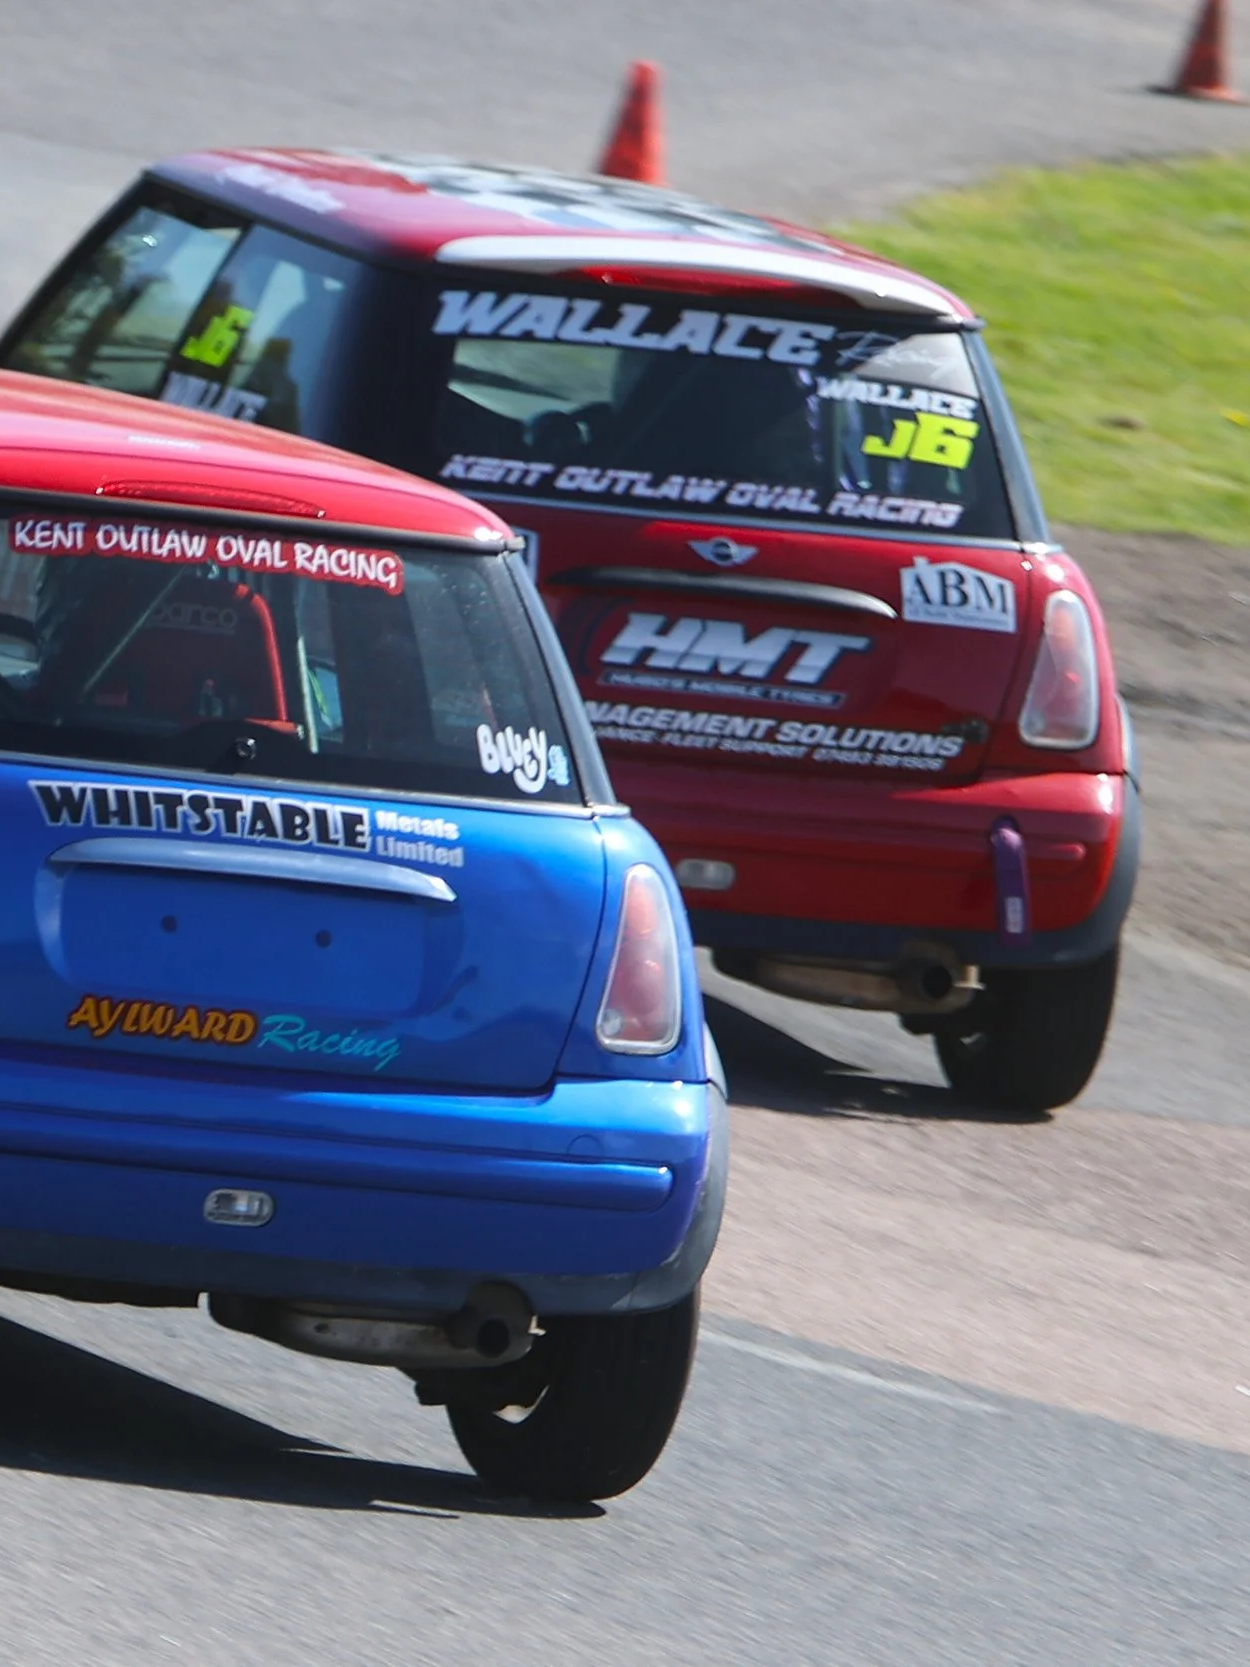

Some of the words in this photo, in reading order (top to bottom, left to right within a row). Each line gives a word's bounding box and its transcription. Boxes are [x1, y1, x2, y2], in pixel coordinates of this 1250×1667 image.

[179, 305, 253, 368] J6
[433, 289, 836, 366] WALLACE
[816, 375, 978, 420] WALLACE
[861, 411, 980, 470] J6
[440, 454, 553, 487] KENT
[554, 466, 726, 504] OUTLAW
[725, 482, 822, 514] OVAL
[827, 492, 964, 530] RACING
[14, 520, 86, 549] KENT
[96, 524, 207, 559] OUTLAW
[216, 535, 287, 569] OVAL
[294, 541, 398, 590] RACING
[907, 568, 1009, 615] ABM
[601, 614, 870, 683] HMT
[583, 700, 777, 741] NAGEMENT
[775, 720, 964, 758] SOLUTIONS
[30, 781, 371, 852] WHITSTABLE
[374, 810, 460, 842] Metals
[375, 834, 465, 868] Limited
[67, 994, 258, 1046] AYLWARD
[257, 1013, 402, 1073] Racing
